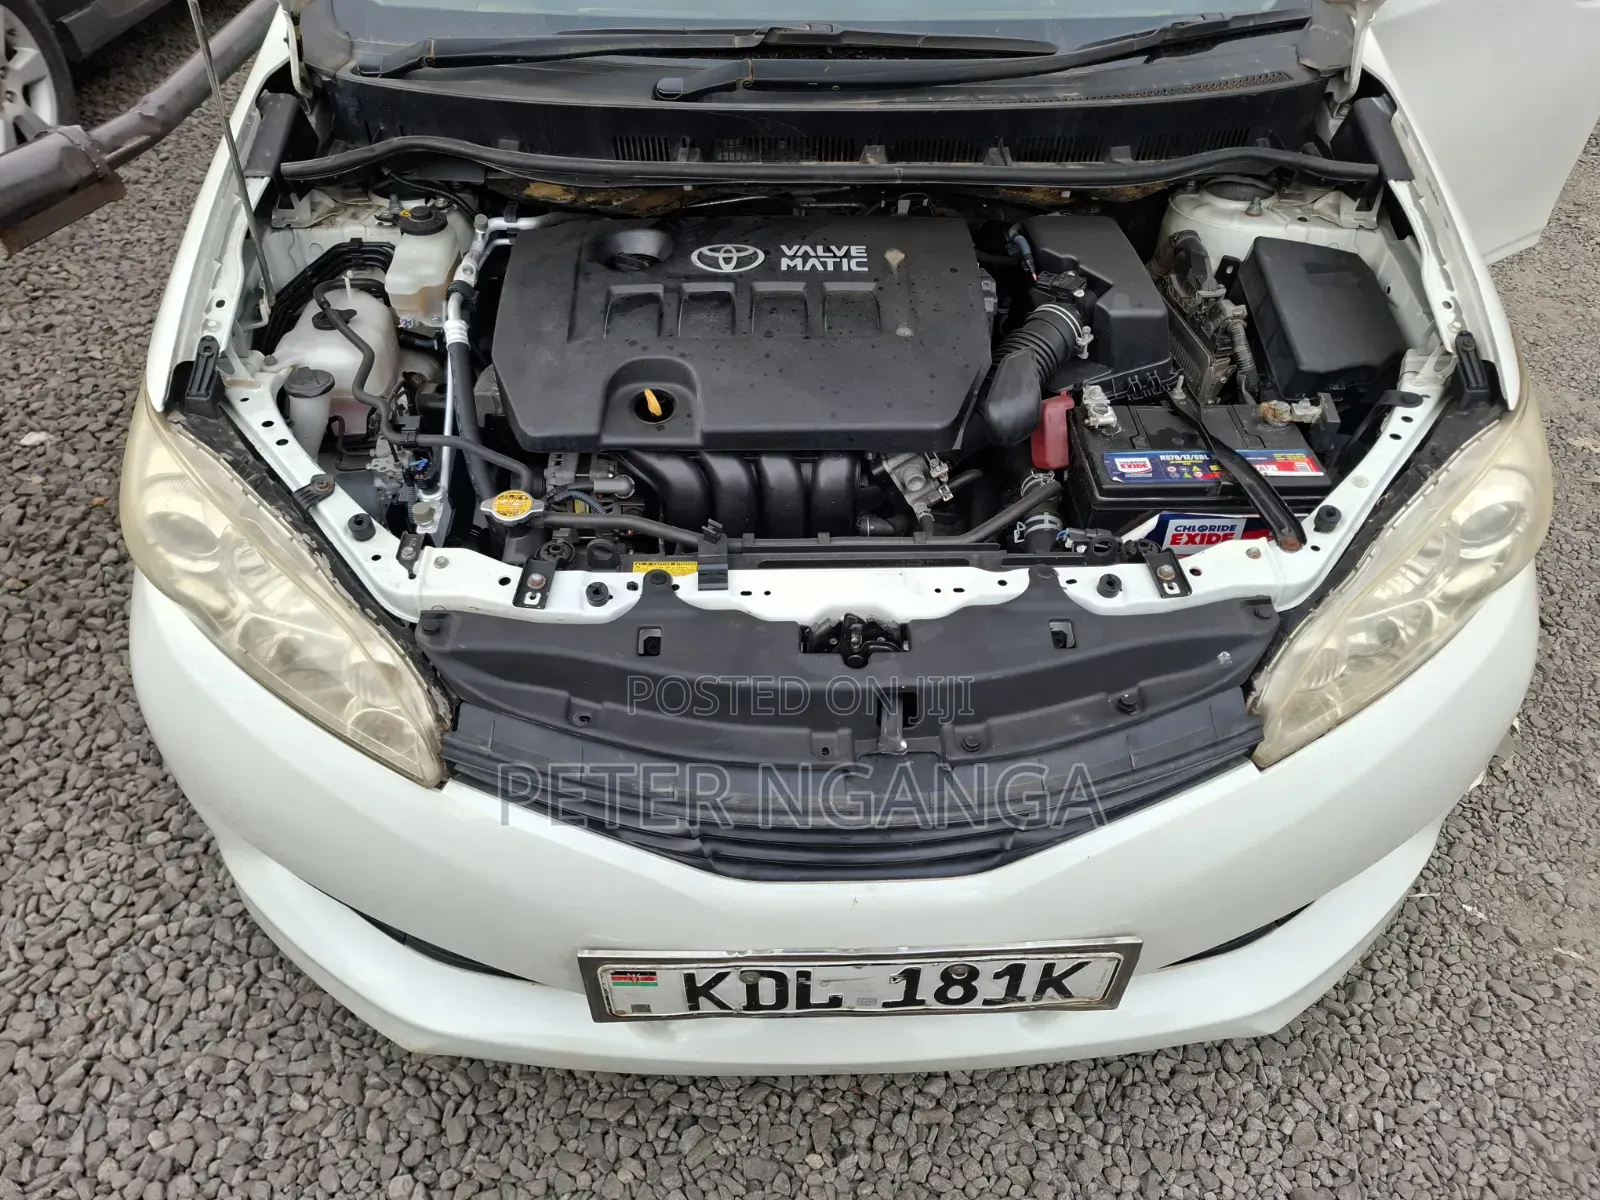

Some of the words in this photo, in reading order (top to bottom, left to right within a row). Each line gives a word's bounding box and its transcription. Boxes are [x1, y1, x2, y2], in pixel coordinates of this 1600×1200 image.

[780, 245, 868, 257] VALVE
[780, 257, 869, 272] MATIC
[1174, 524, 1238, 533] CHLORIDE
[683, 967, 844, 1012] KDL
[881, 958, 1094, 1009] 181K
